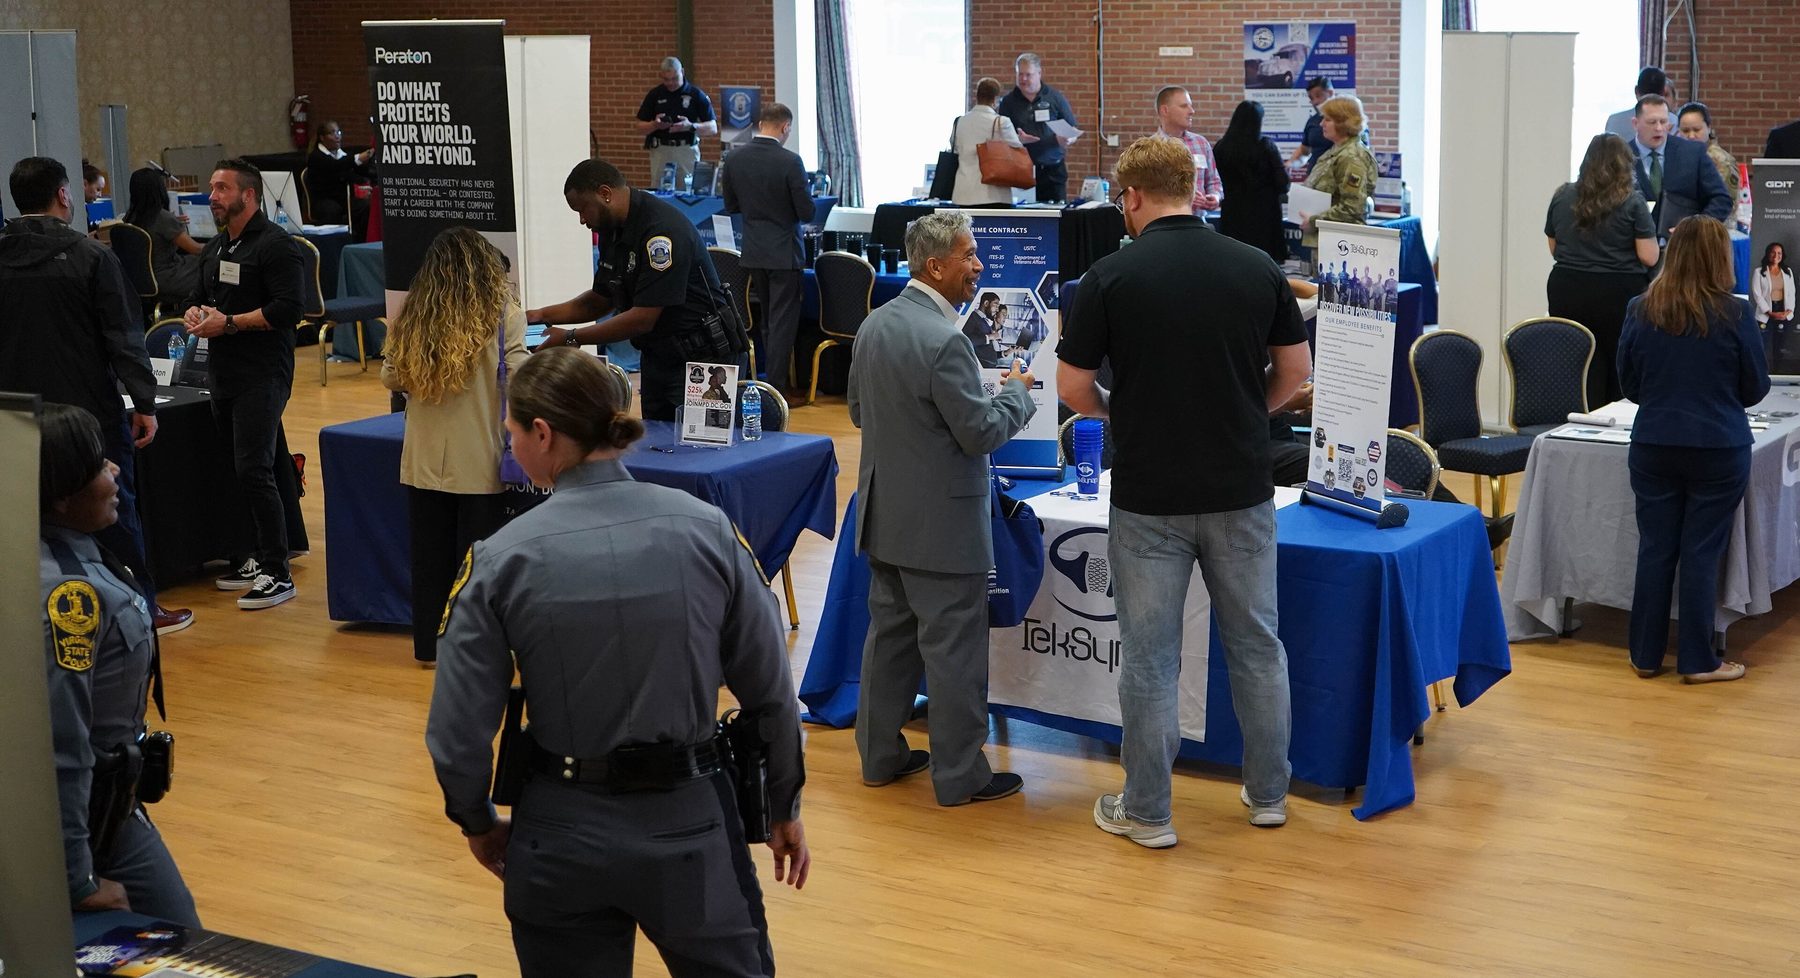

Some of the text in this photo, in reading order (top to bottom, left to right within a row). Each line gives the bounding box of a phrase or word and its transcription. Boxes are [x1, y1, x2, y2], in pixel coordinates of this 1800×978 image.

[375, 47, 432, 64] Peraton
[377, 81, 441, 101] DO WHAT
[378, 102, 451, 123] PROTECTS
[380, 123, 476, 145] YOUR WORLD.
[382, 145, 476, 166] AND BEYOND.
[382, 177, 495, 188] OUR NATIONAL SECURITY HAS NEVER
[384, 188, 398, 196] BEEN
[400, 188, 408, 196] SO
[410, 188, 441, 197] CRITICAL
[448, 190, 458, 198] OR
[459, 190, 496, 199] CONTESTED.
[384, 198, 401, 206] START
[410, 199, 434, 208] CAREER
[436, 200, 452, 208] WITH
[454, 200, 466, 208] THE
[466, 201, 494, 210] COMPANY
[385, 208, 497, 221] THAT'S DOING SOMETHING ABOUT IT.
[1320, 300, 1392, 322] DISCOVER NEW POSSIBILITIES
[1336, 318, 1359, 328] EMPLOYEE
[1360, 322, 1382, 332] BENEFITS
[64, 646, 90, 656] STATE
[63, 656, 90, 668] POLICE
